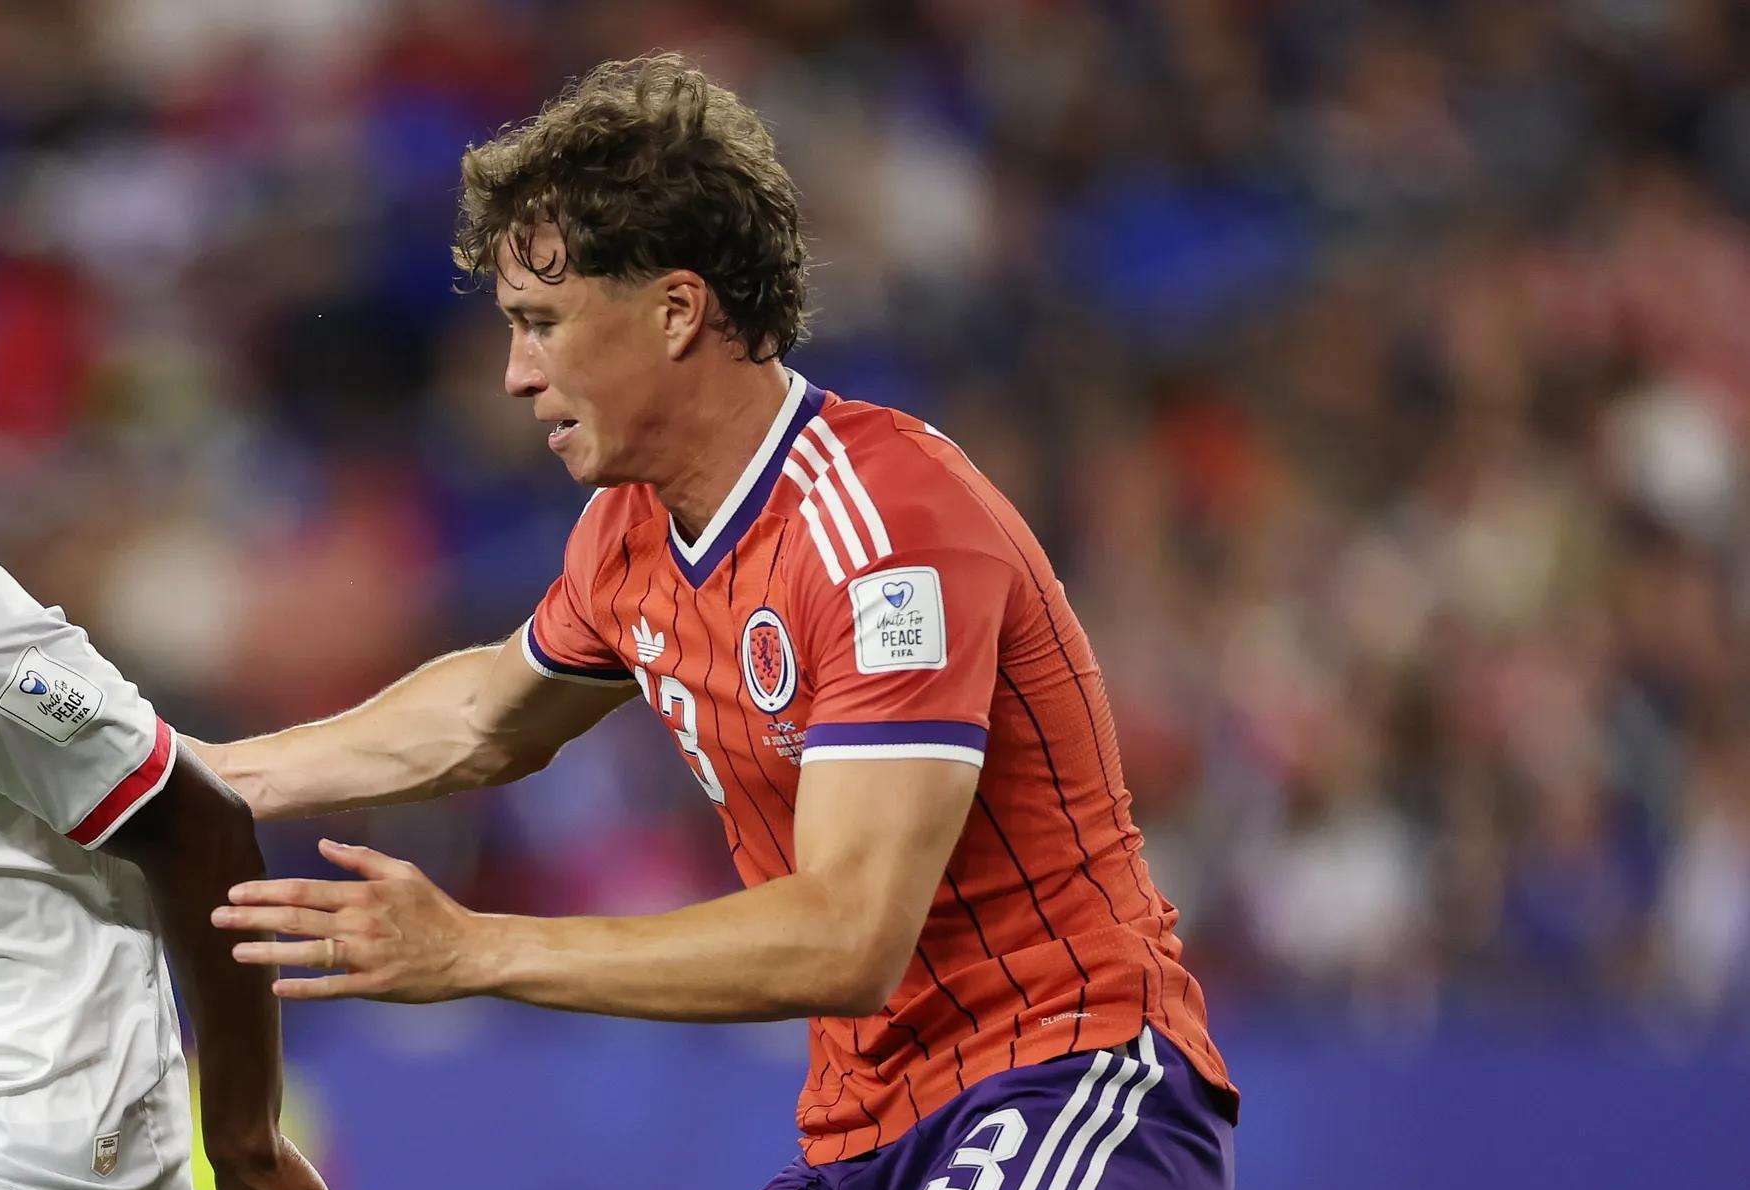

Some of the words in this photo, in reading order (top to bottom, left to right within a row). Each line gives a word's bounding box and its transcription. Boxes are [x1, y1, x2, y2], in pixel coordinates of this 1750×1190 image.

[881, 629, 922, 647] PEACE
[891, 649, 913, 658] FIFA
[51, 688, 85, 723] PEACE
[71, 707, 90, 724] FIFA
